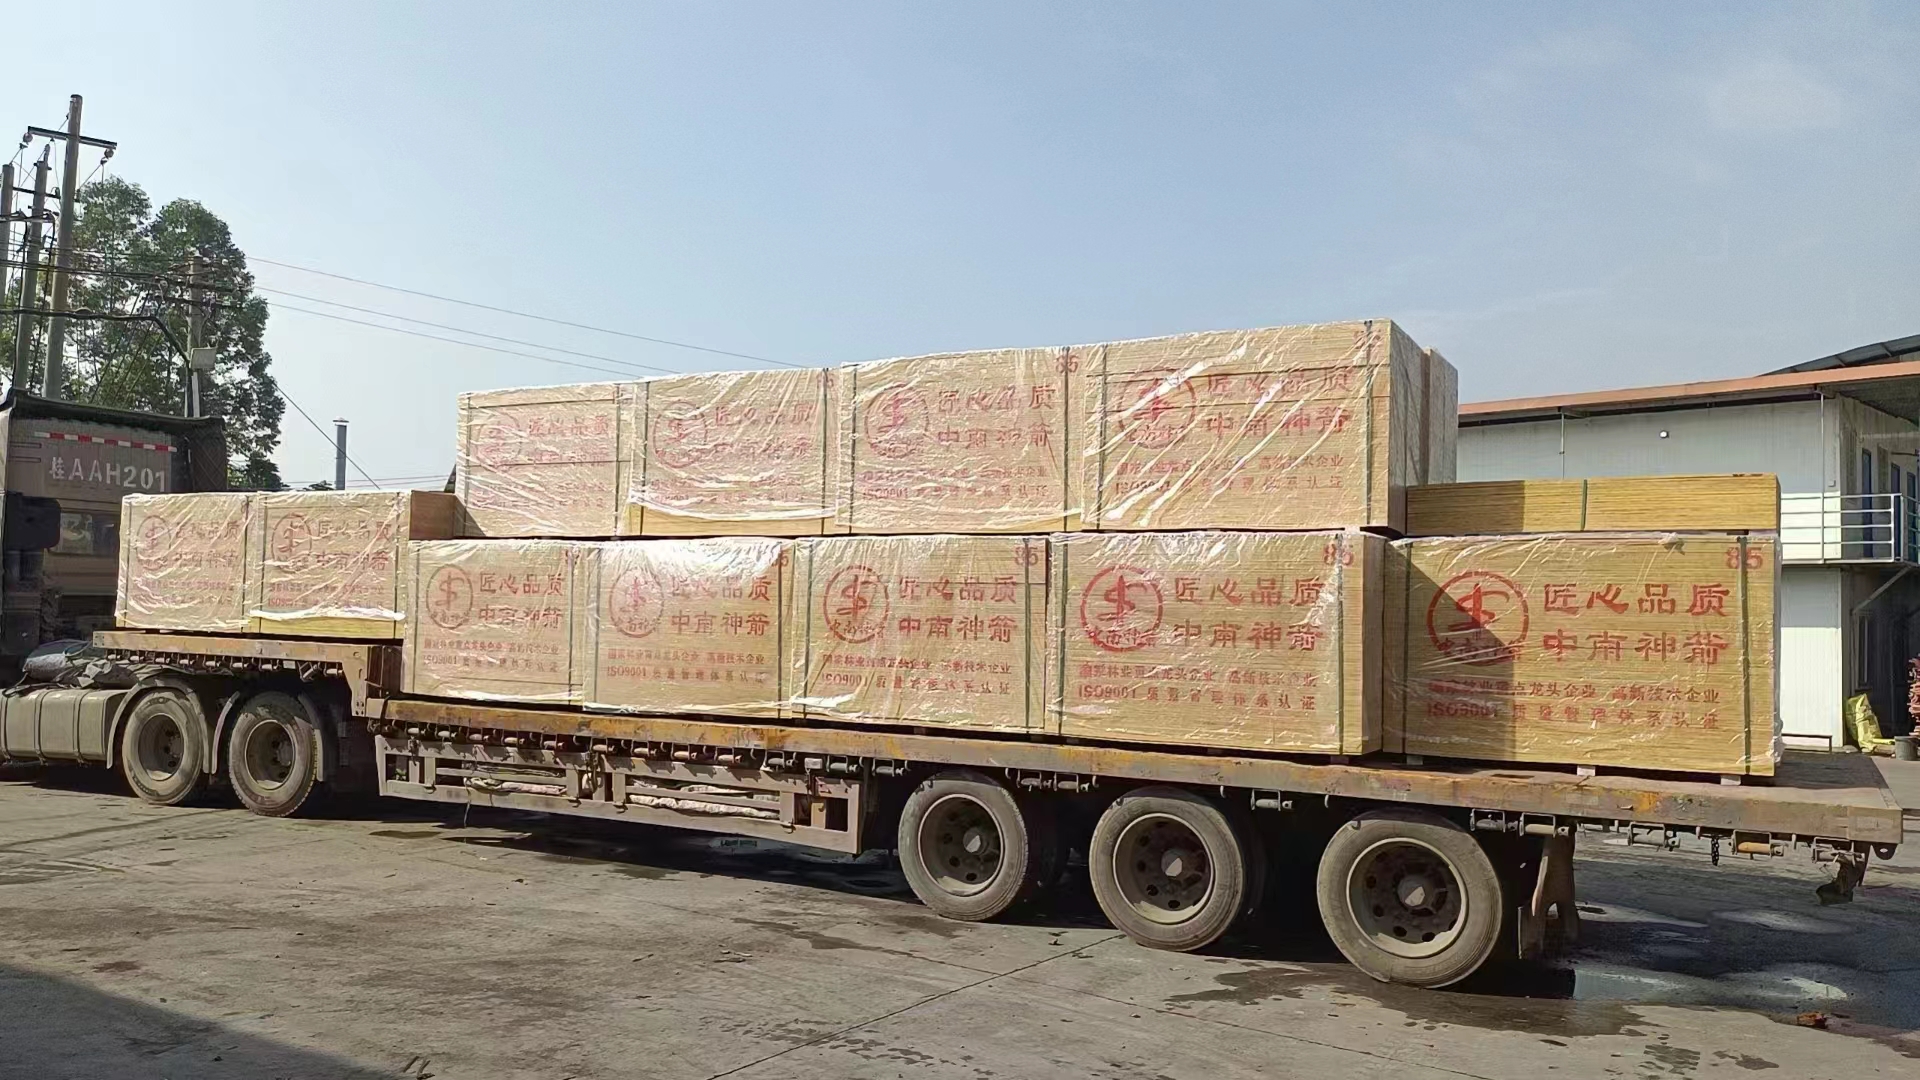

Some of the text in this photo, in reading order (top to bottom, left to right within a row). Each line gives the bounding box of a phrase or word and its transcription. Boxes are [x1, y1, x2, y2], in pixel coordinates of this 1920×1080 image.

[49, 456, 165, 492] 桂AAH201
[1725, 546, 1763, 570] 85
[899, 575, 1017, 604] 匠心品质
[1174, 576, 1325, 608] 匠心品质
[1544, 583, 1730, 617] 匠心品质
[671, 608, 770, 637] 中南神箭
[898, 614, 1018, 643] 中南神箭
[1174, 618, 1324, 651] 中南神箭
[1543, 628, 1730, 665] 中南神箭
[607, 665, 647, 677] ISO9001
[1079, 684, 1137, 699] ISO9001
